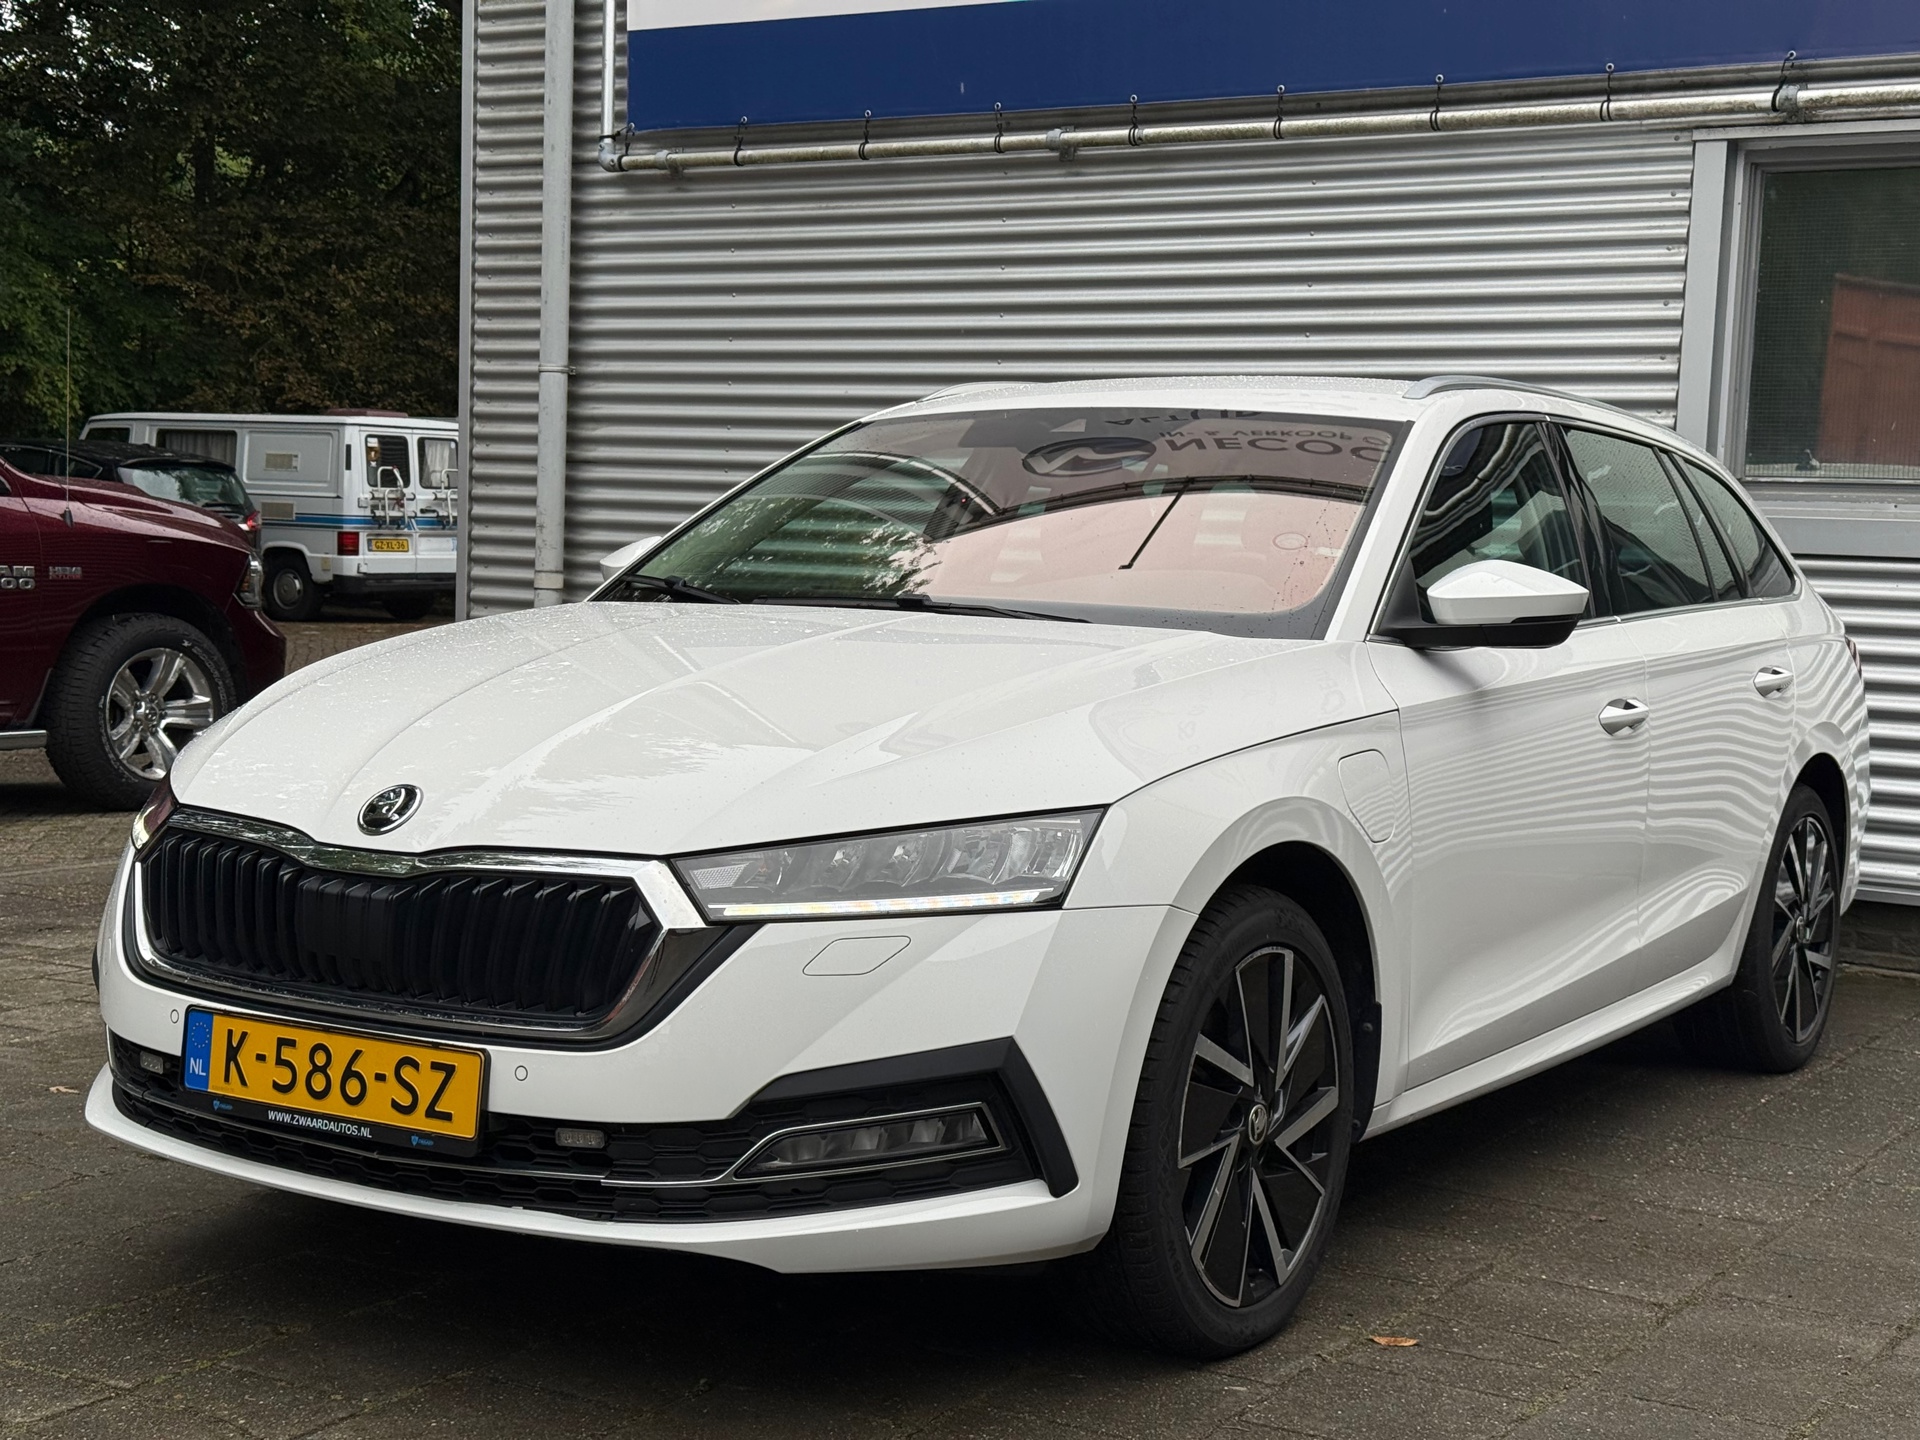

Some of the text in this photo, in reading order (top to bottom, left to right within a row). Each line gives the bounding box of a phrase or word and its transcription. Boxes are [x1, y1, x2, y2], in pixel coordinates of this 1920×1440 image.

[374, 541, 406, 550] GZ-XL-36
[189, 1057, 207, 1076] NL
[223, 1028, 457, 1122] K-586-SZ
[268, 1110, 373, 1138] WWW.ZWAARDAUTOS.NL
